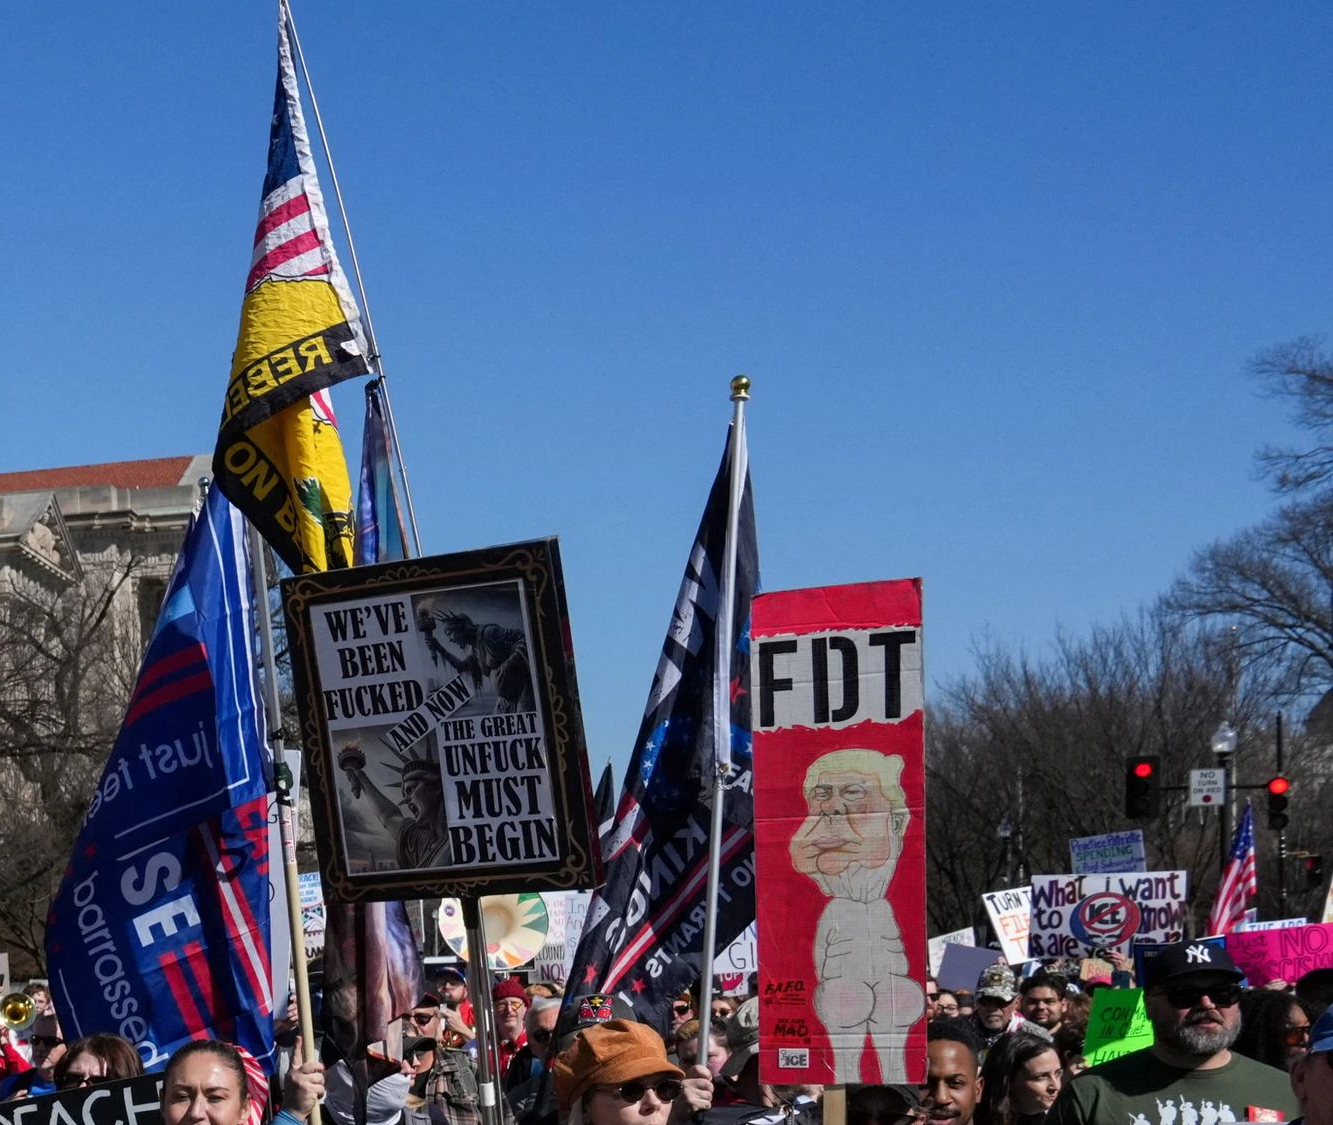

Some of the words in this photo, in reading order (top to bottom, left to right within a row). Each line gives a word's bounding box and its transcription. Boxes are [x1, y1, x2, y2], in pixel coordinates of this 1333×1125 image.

[323, 601, 409, 643] WE'VE
[337, 640, 406, 680] BEEN
[758, 630, 917, 727] FDT
[323, 679, 424, 721] FUCKED
[389, 711, 430, 752] AND
[425, 676, 472, 723] NOW
[440, 719, 476, 741] THE
[480, 713, 537, 737] GREAT
[443, 737, 546, 777] UNFUCK
[454, 775, 542, 820] MUST
[448, 816, 558, 866] BEGIN
[1076, 845, 1133, 862] SPENDING
[986, 892, 1023, 915] TURN
[1033, 906, 1063, 931] to
[1088, 902, 1122, 925] ICE
[1046, 933, 1080, 958] are
[1278, 925, 1329, 959] NO
[72, 870, 169, 1069] barrassed
[774, 1023, 809, 1037] MAD
[1101, 1024, 1112, 1036] IN
[786, 1054, 807, 1066] ICE
